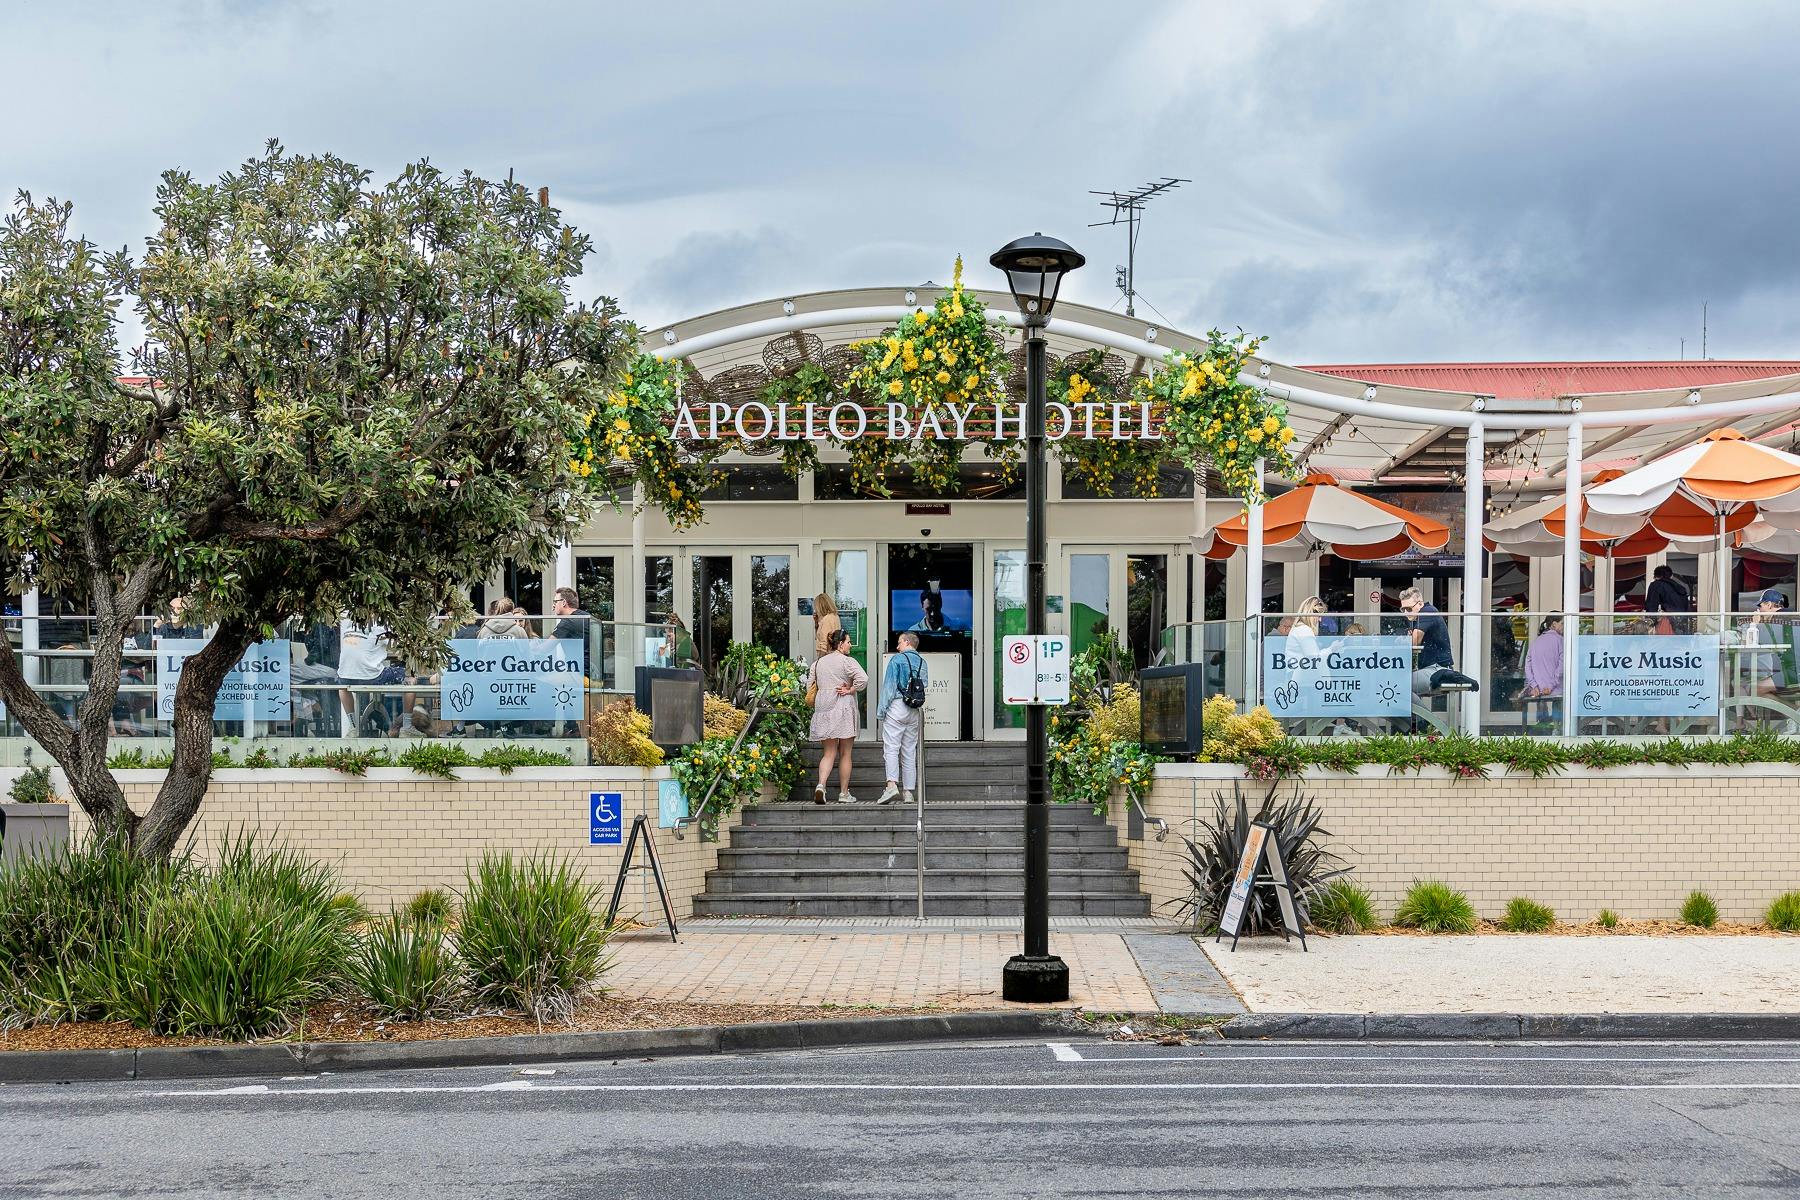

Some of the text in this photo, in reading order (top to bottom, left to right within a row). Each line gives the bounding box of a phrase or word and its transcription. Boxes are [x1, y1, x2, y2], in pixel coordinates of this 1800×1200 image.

[667, 401, 1162, 441] APOLLO BAY HOTEL
[1042, 641, 1063, 658] 1P
[232, 655, 281, 673] usic
[447, 655, 580, 673] Beer Garden
[1272, 652, 1405, 670] Beer Garden
[1588, 652, 1702, 669] Live Music
[490, 683, 536, 693] OUT THE
[1315, 680, 1361, 690] OUT THE
[1604, 679, 1705, 687] APOLLOBAYHOTEL.COM.AU
[499, 695, 528, 706] BACK
[1324, 692, 1352, 703] BACK
